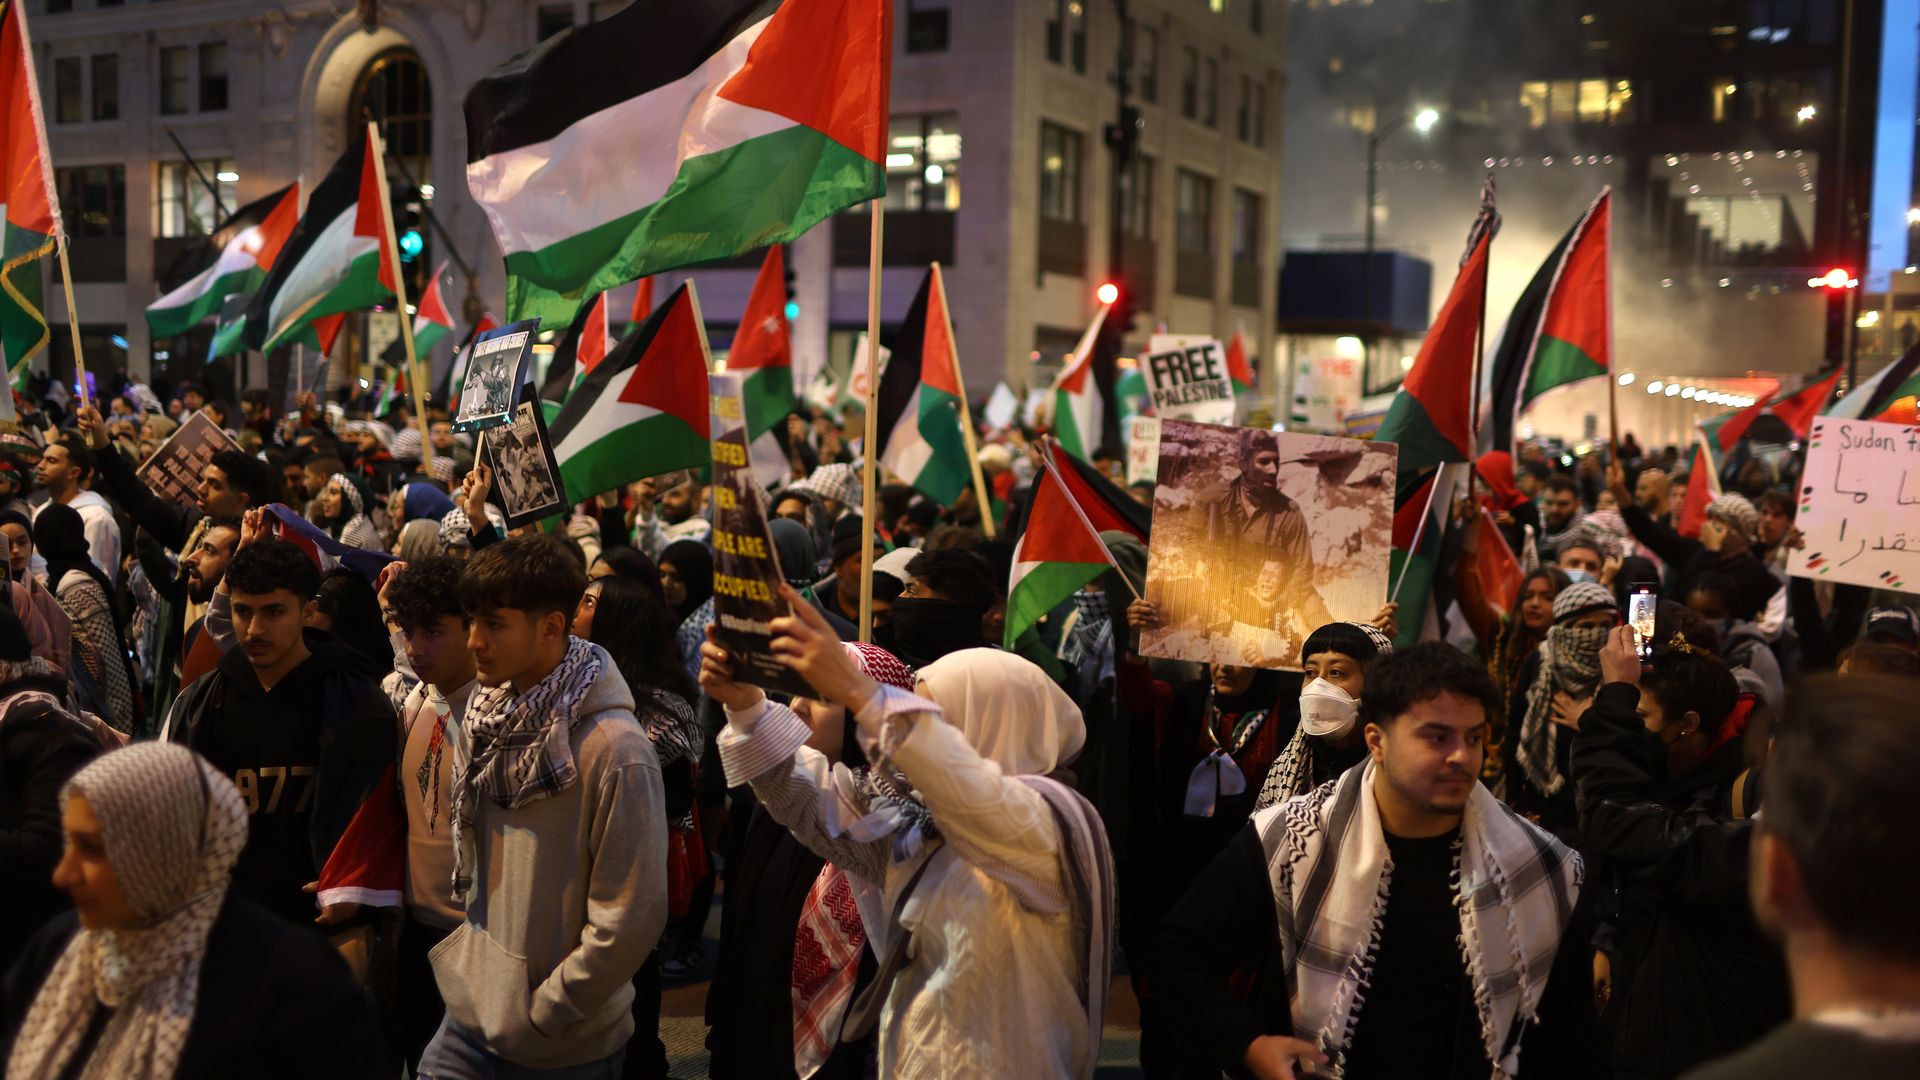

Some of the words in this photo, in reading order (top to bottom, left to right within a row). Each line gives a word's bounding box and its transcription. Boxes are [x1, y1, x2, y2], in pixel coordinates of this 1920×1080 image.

[1149, 345, 1221, 388] FREE
[1153, 381, 1229, 409] PALESTINE
[1840, 424, 1896, 452] Sudan
[736, 533, 768, 559] ARE
[235, 766, 316, 815] 977
